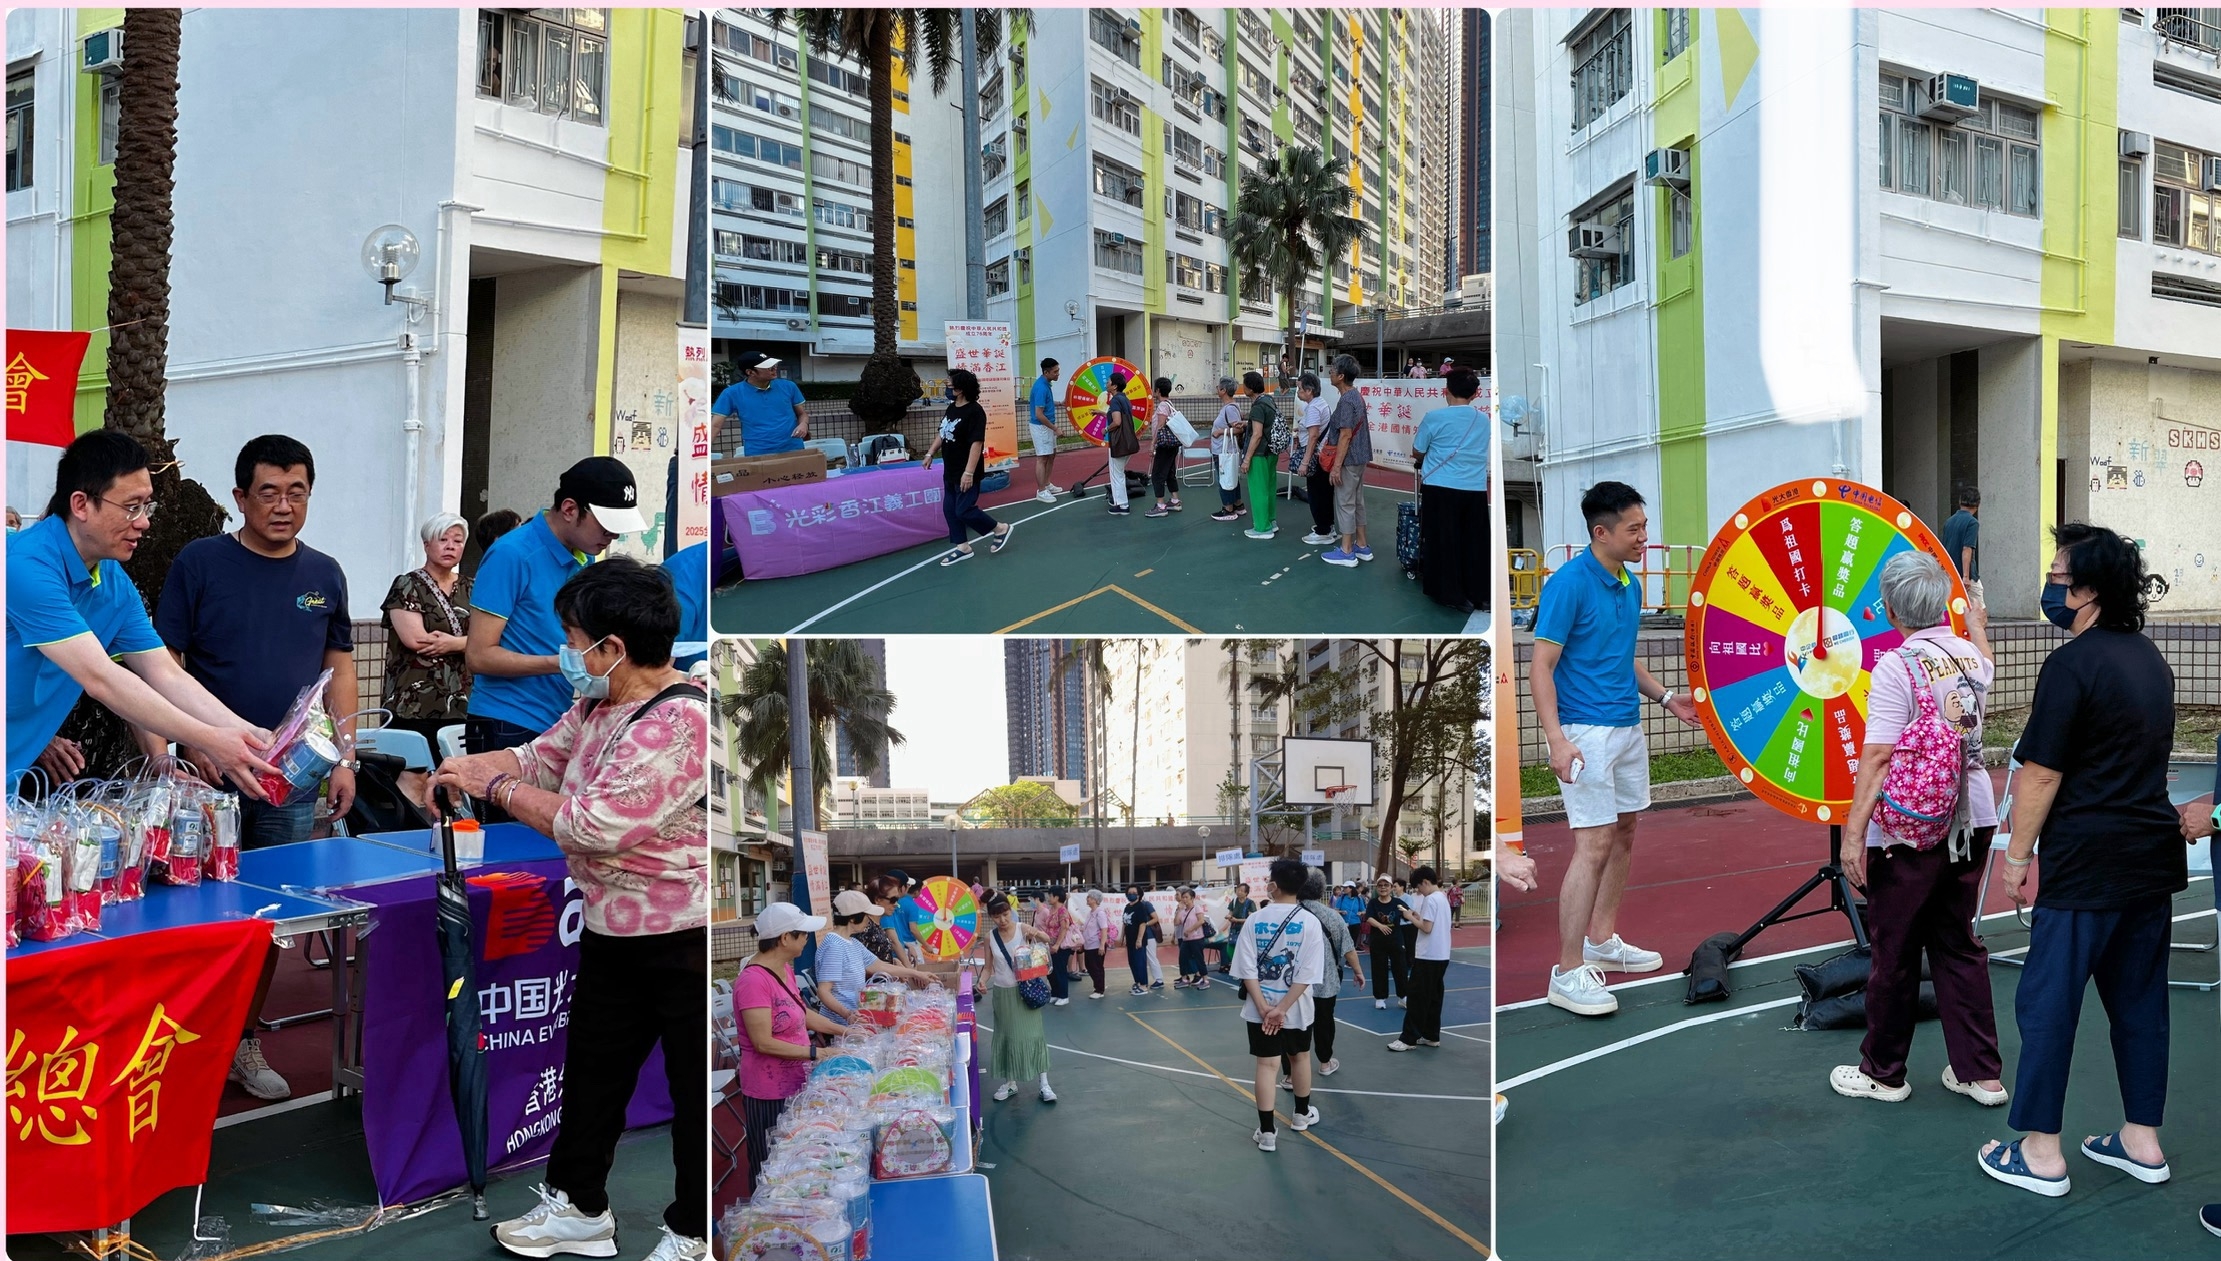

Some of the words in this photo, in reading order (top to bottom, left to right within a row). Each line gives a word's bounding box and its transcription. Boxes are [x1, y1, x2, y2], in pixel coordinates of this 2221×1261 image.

[785, 491, 941, 529] 光彩香江義工團
[1833, 517, 1863, 598] 答題贏獎品
[1709, 641, 1761, 655] 向祖國比
[1922, 657, 1979, 682] PEANUTS
[1784, 721, 1809, 783] 向祖國比
[1834, 709, 1859, 784] 題贏獎品
